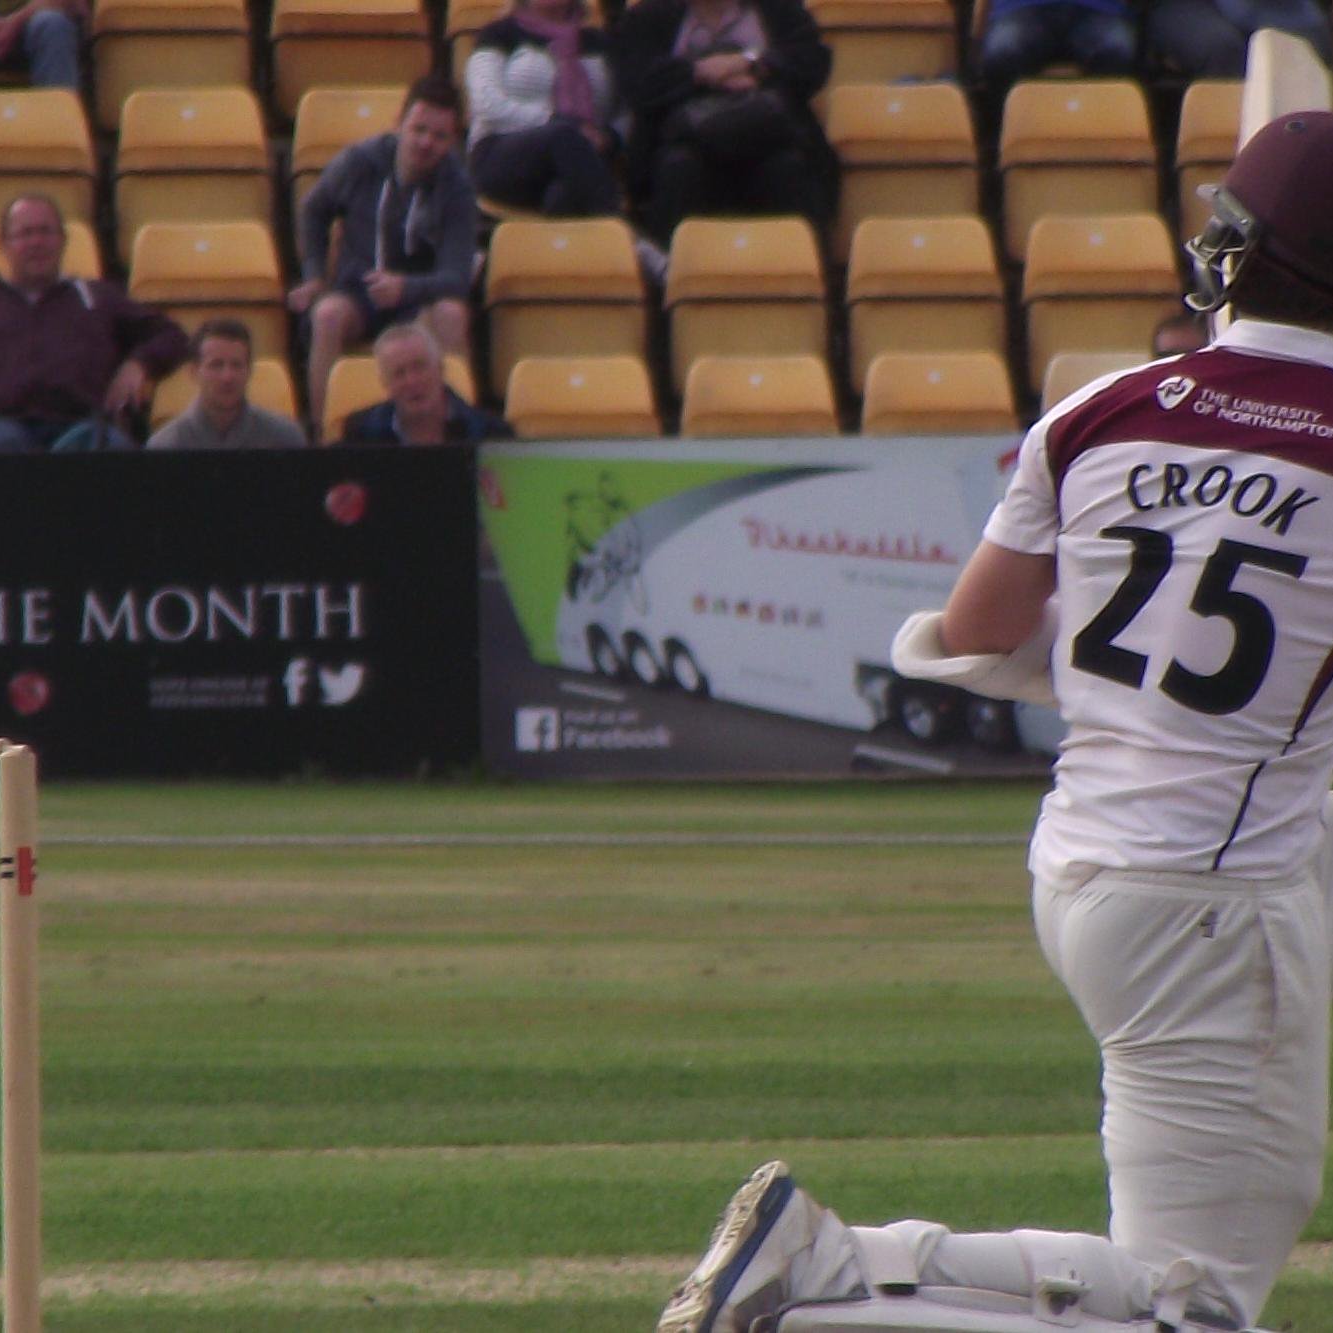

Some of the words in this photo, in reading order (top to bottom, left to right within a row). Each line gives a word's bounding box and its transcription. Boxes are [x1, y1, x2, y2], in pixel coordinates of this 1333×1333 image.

[1193, 401, 1215, 416] OF
[1200, 387, 1231, 407] THE
[1232, 396, 1324, 423] UNIVERSITY
[1126, 462, 1321, 537] CROOK
[79, 583, 366, 645] MONTH
[1070, 525, 1310, 716] 25
